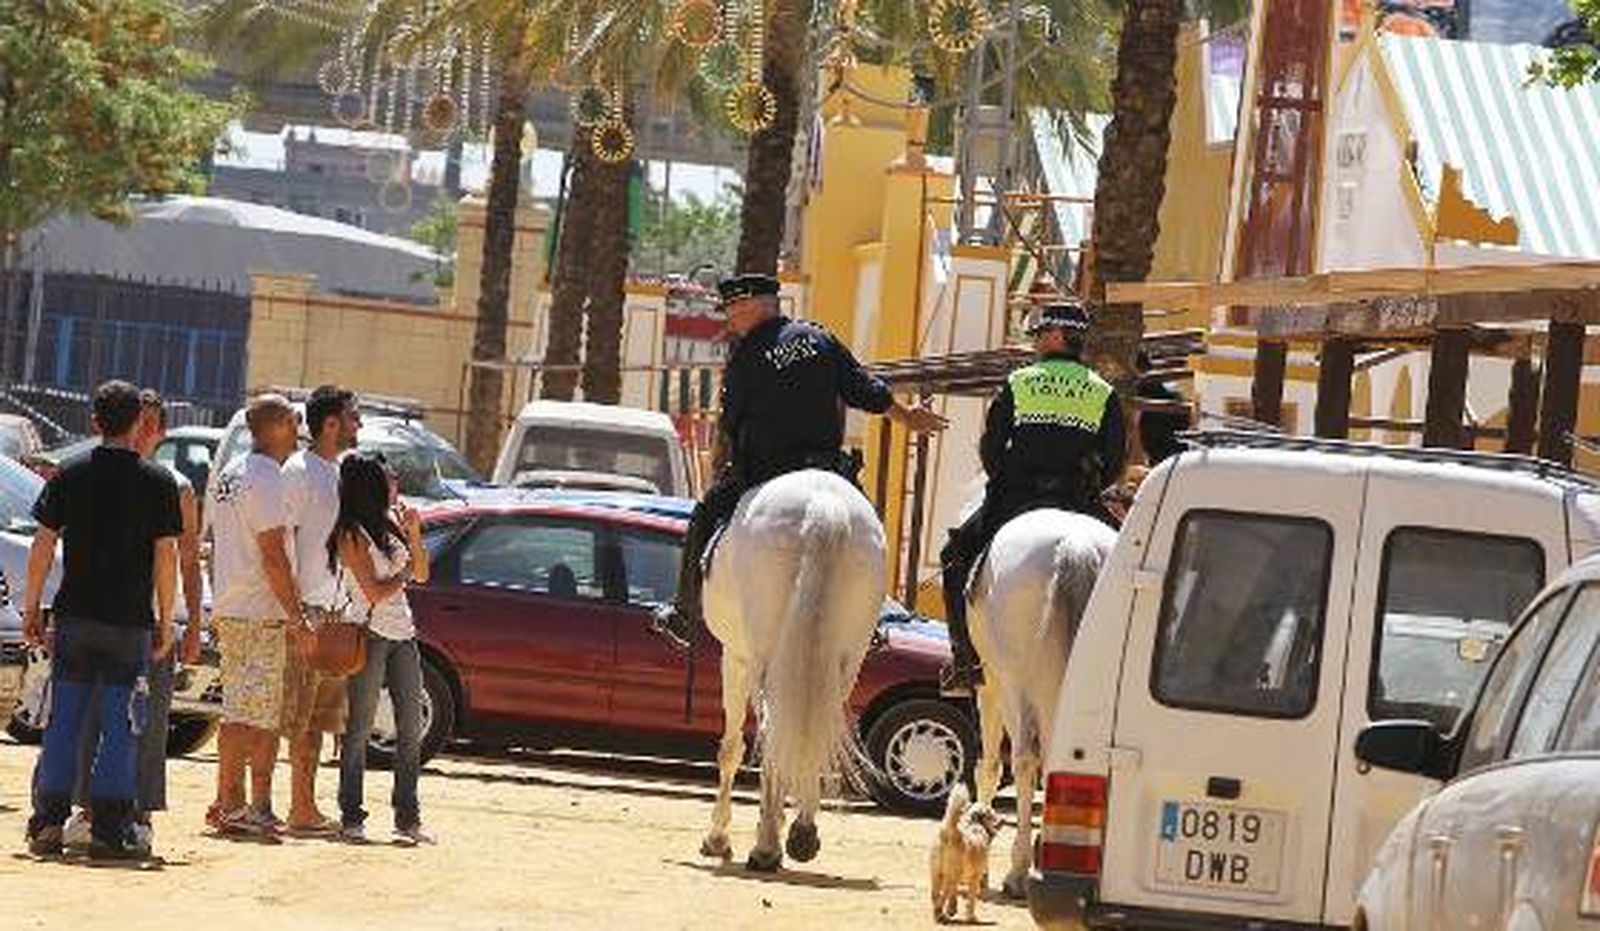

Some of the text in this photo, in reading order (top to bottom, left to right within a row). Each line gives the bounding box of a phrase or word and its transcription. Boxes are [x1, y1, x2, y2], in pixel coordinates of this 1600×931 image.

[1030, 384, 1085, 398] LOCAL
[1182, 808, 1261, 843] 0819
[1185, 850, 1249, 884] DWB
